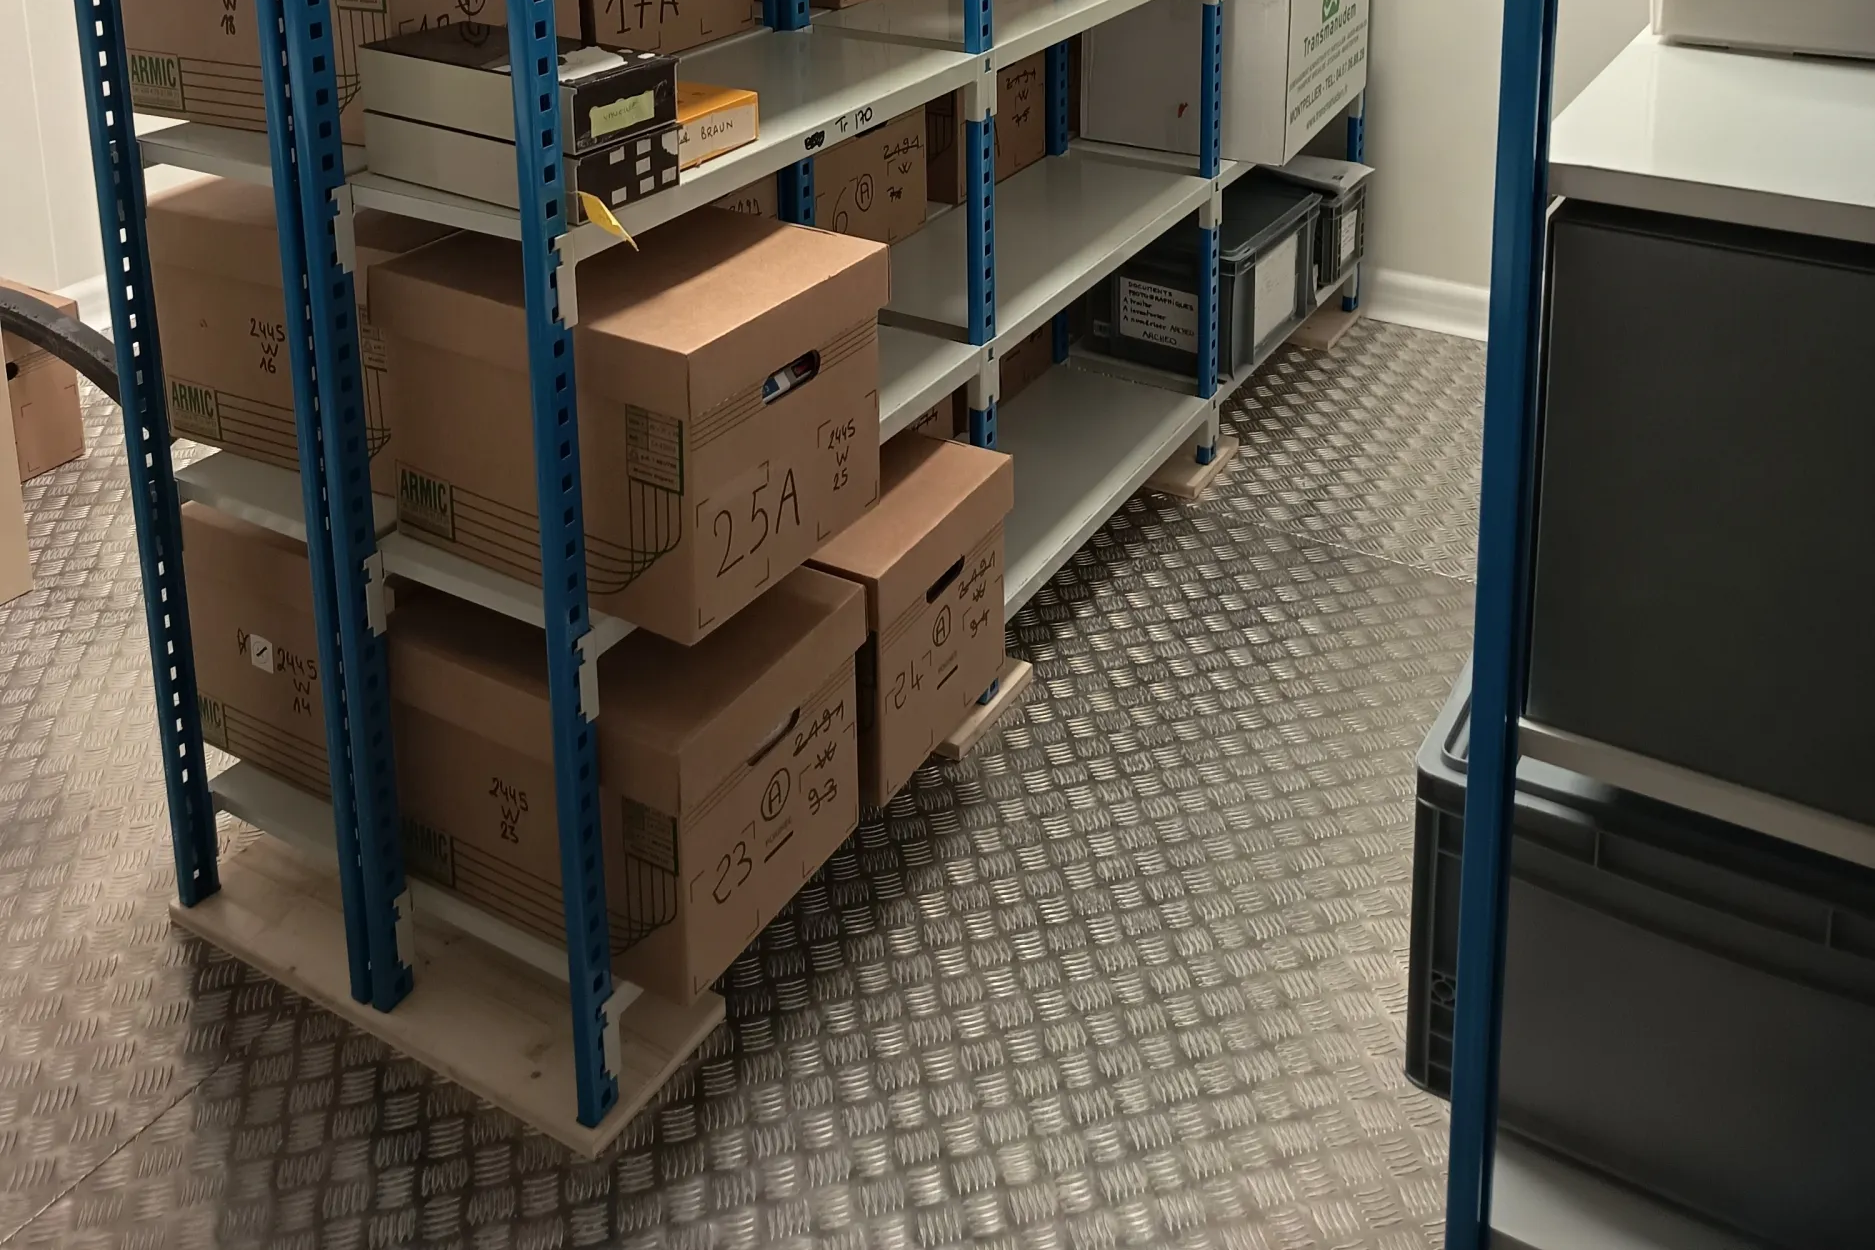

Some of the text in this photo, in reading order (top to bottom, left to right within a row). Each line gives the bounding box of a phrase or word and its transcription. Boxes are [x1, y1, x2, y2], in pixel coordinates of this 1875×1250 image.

[220, 14, 236, 36] 18
[1303, 2, 1358, 58] Transmanudem
[131, 54, 177, 88] ARMIC
[1289, 82, 1322, 126] MONTPELLIER
[700, 119, 734, 141] BRAUN
[897, 161, 913, 175] W
[1128, 281, 1173, 297] DOCUMENTS
[249, 317, 286, 342] 2445
[261, 342, 279, 358] W
[259, 356, 277, 374] 16
[172, 381, 214, 419] ARMIC
[827, 418, 856, 450] 2445
[836, 446, 850, 467] W
[401, 468, 448, 514] ARMIC
[833, 467, 849, 491] 25
[713, 468, 801, 578] 25A
[276, 647, 318, 680] 2445
[293, 678, 311, 695] W
[894, 659, 924, 710] 24
[199, 694, 222, 728] MIC
[293, 696, 312, 717] 14
[488, 776, 529, 812] 2445
[501, 805, 520, 825] W
[500, 820, 519, 844] 23
[712, 841, 753, 905] 23
